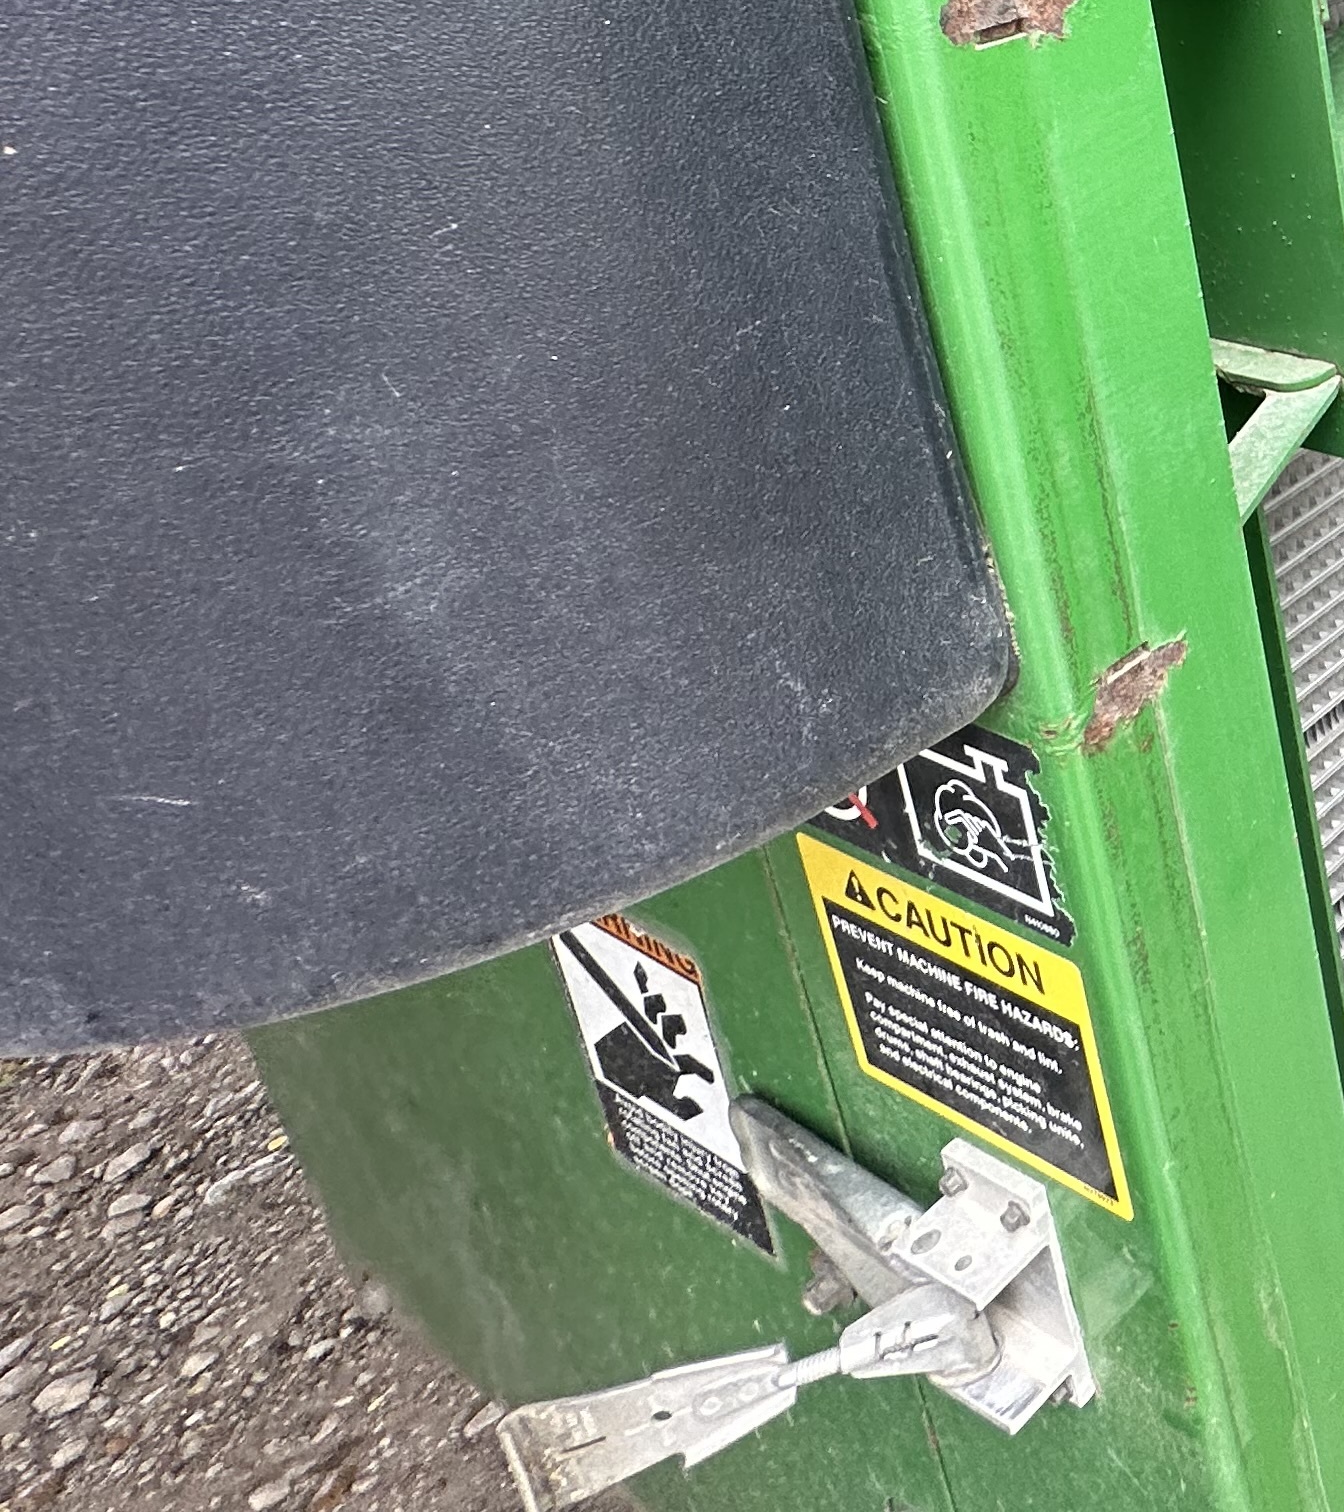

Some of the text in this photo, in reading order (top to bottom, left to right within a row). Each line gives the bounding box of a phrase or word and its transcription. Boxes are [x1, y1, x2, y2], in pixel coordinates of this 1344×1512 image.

[832, 915, 893, 956] PREVENT
[897, 948, 962, 991] MACHINE
[964, 981, 999, 1009] FIRE
[877, 887, 1044, 994] CAUTION
[856, 958, 885, 983] Keep
[887, 976, 935, 1007] machine
[937, 1000, 961, 1021] free
[963, 1016, 975, 1028] of
[1011, 1039, 1036, 1060] and
[865, 992, 1041, 1094] Pay special attention to engine
[880, 1044, 900, 1061] and
